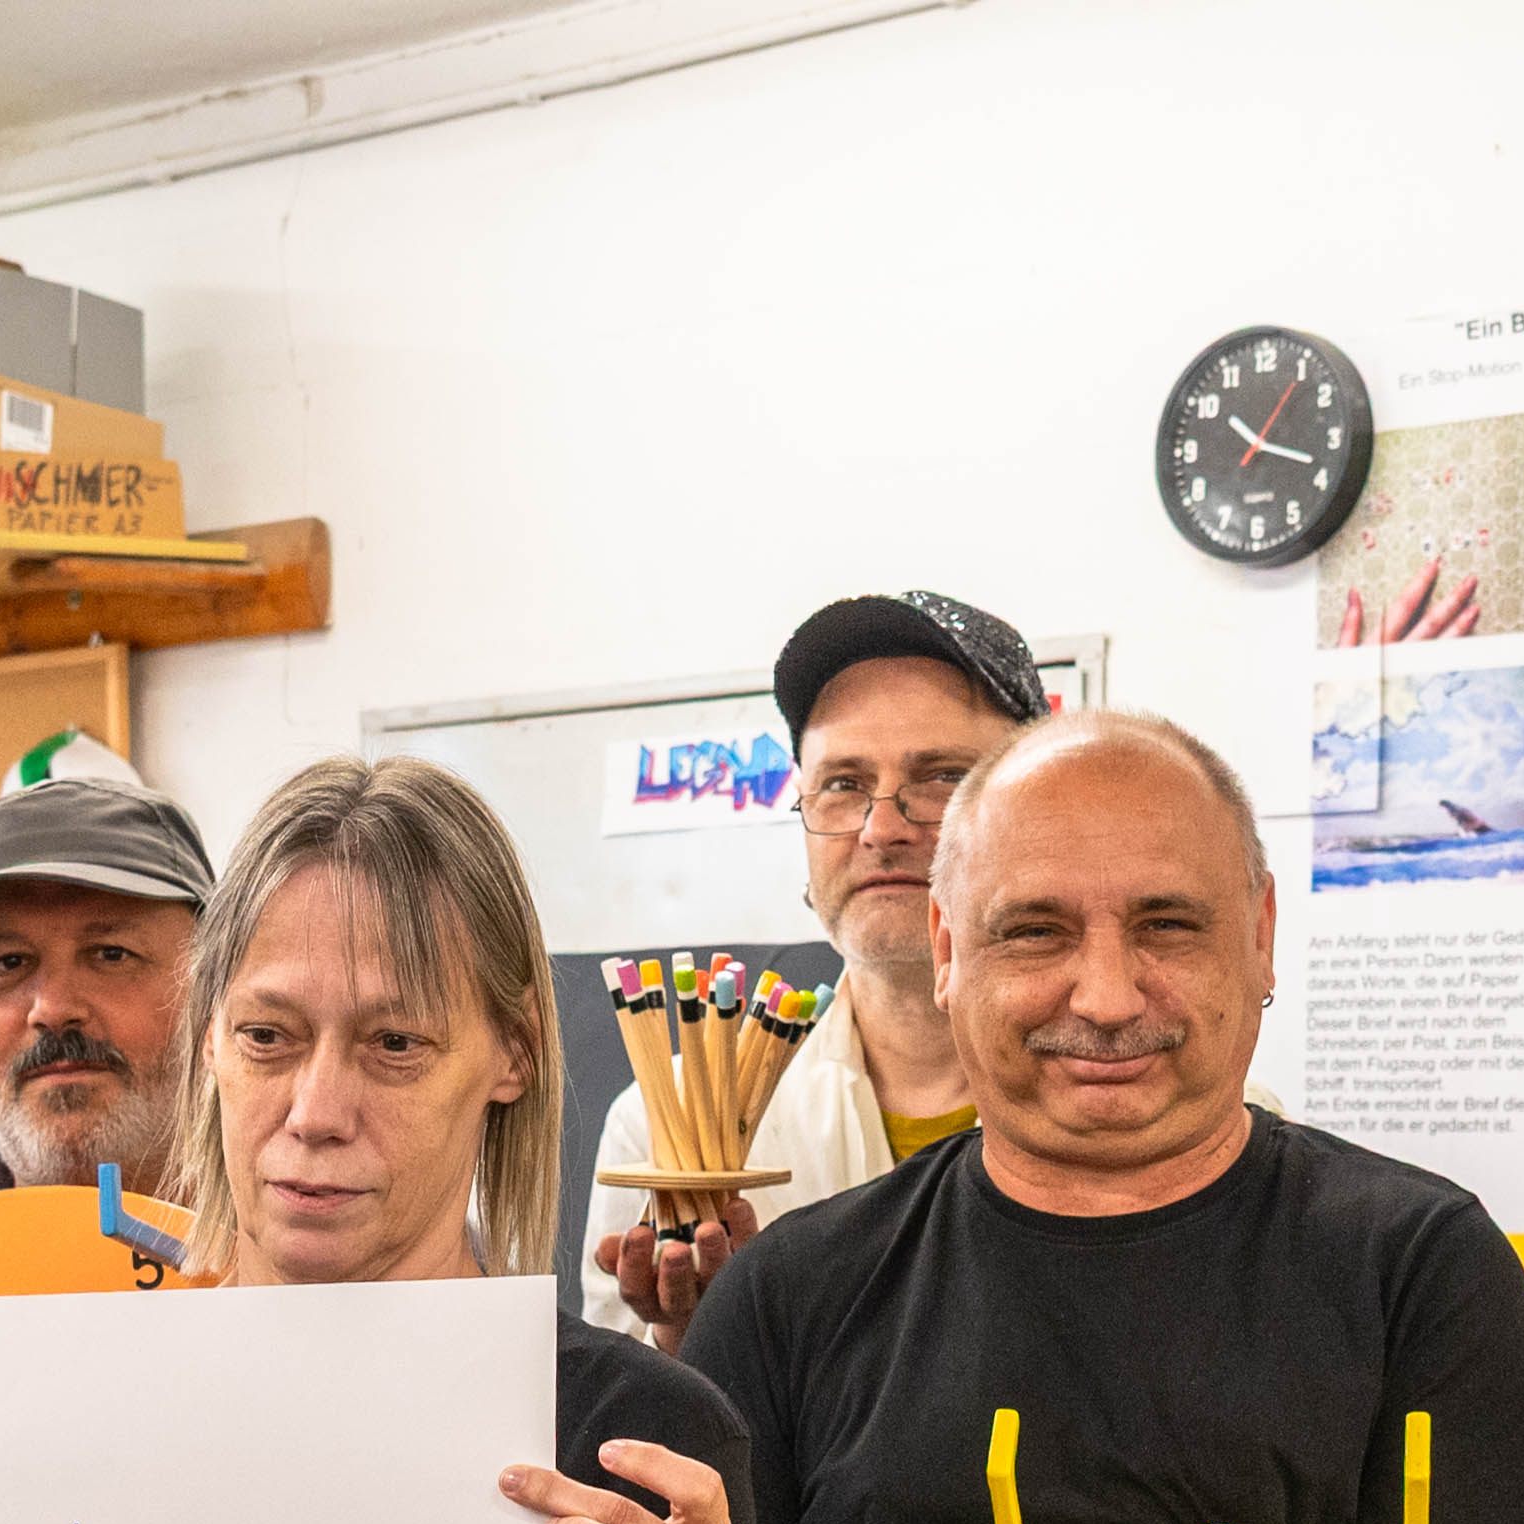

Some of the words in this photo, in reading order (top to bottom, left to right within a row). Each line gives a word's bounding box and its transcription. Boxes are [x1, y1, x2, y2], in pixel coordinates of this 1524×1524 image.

[1255, 350, 1277, 373] 12
[1297, 358, 1306, 381] 1
[1222, 365, 1240, 389] 11
[1198, 393, 1220, 419] 10
[1317, 383, 1332, 408] 2
[1327, 426, 1341, 450] 3
[1184, 439, 1198, 463] 9
[1191, 477, 1206, 502] 8
[1313, 468, 1327, 491] 4
[1218, 505, 1232, 530] 7
[1286, 500, 1300, 524] 5
[1250, 516, 1265, 540] 6
